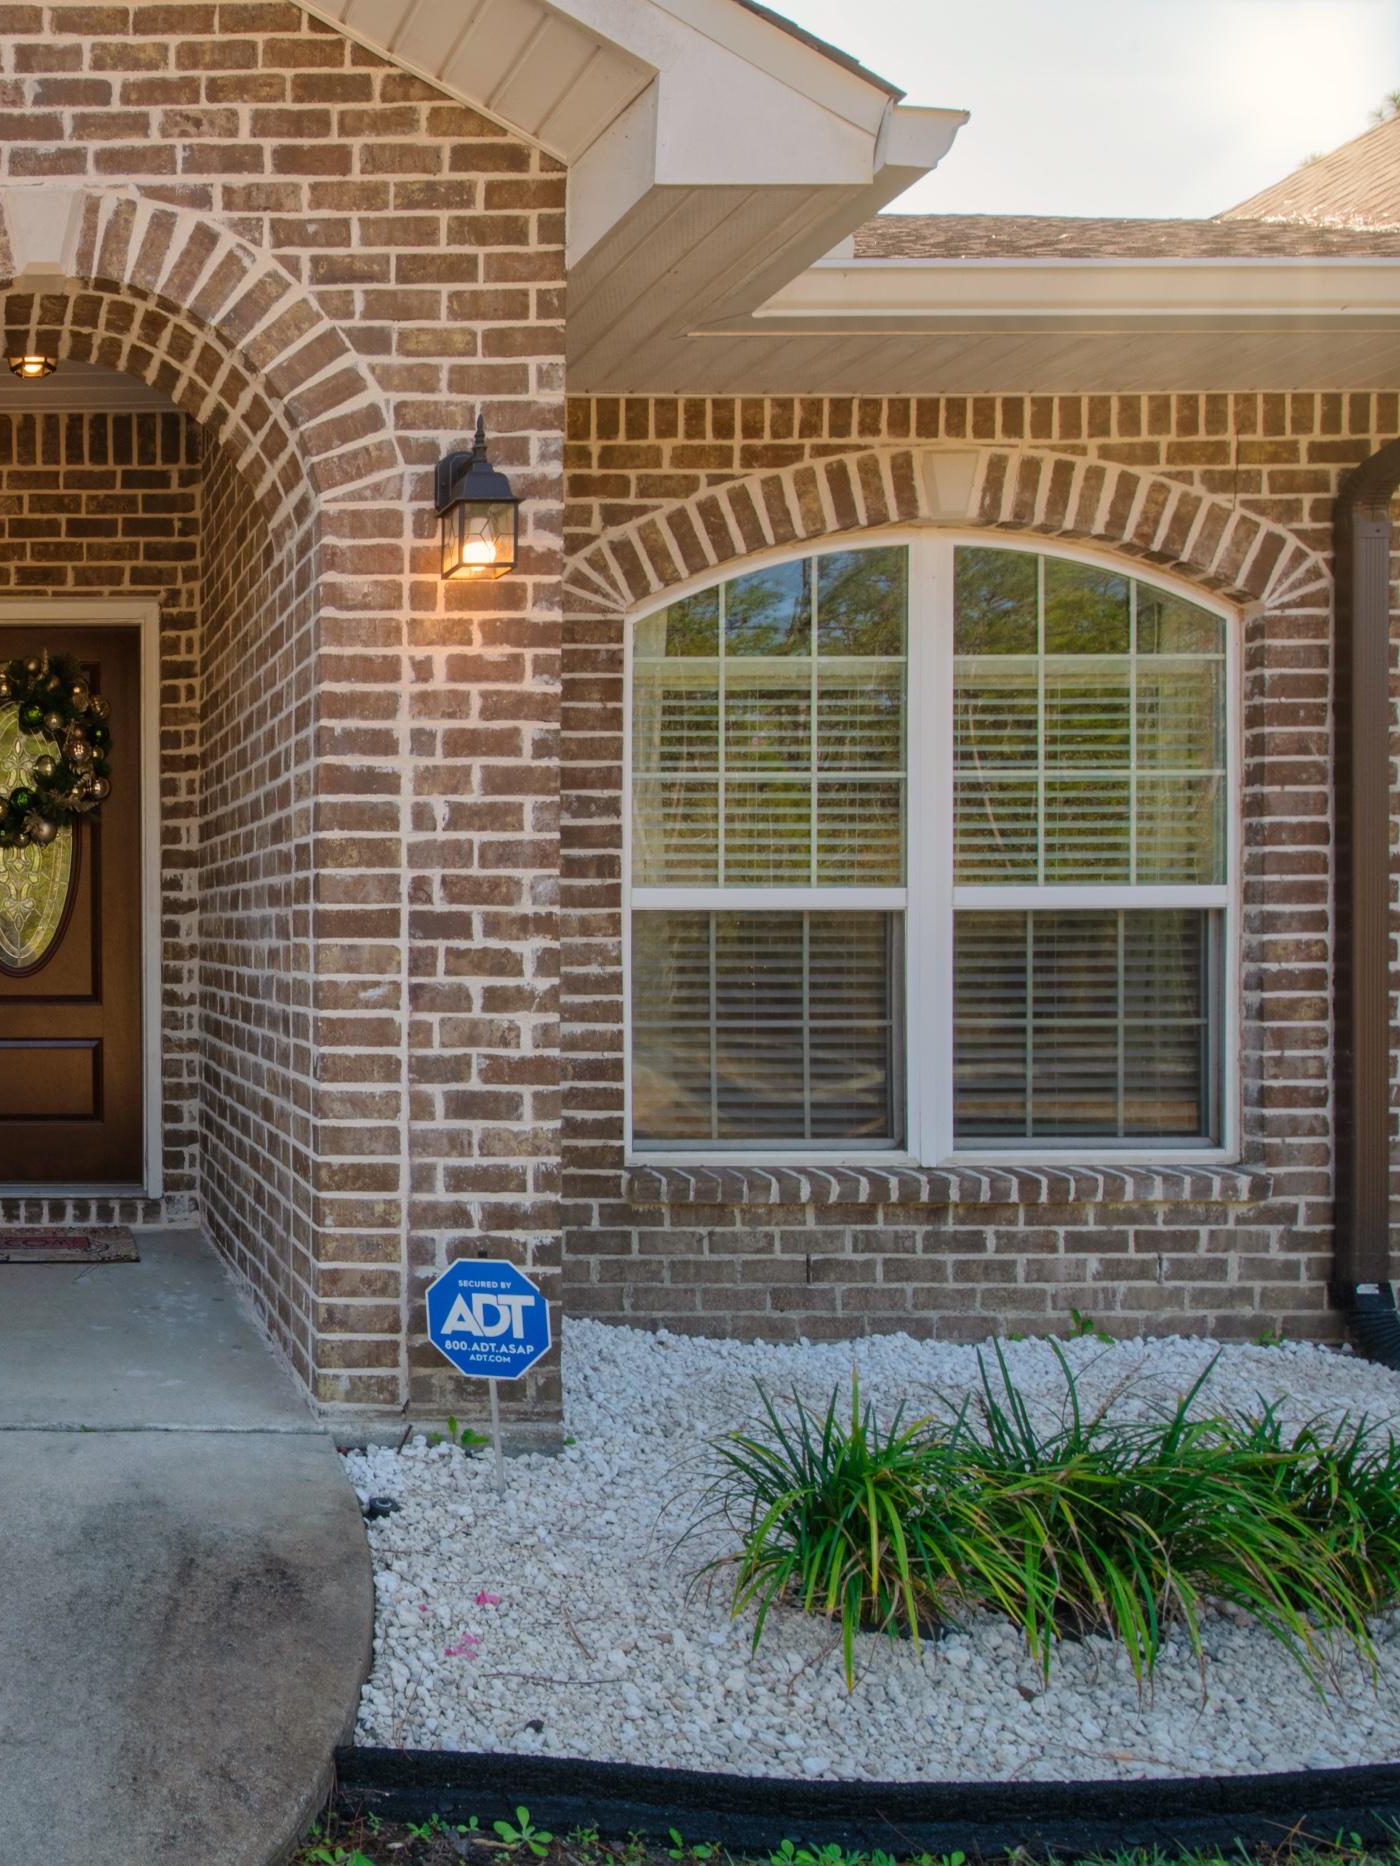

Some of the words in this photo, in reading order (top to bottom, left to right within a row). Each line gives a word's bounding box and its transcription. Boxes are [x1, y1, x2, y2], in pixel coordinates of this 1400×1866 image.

[458, 1279, 498, 1289] SECURED
[500, 1281, 512, 1289] BY
[440, 1292, 535, 1339] ADT
[444, 1340, 534, 1355] 800.ADT.ASAP
[469, 1354, 511, 1363] ADT.COM
